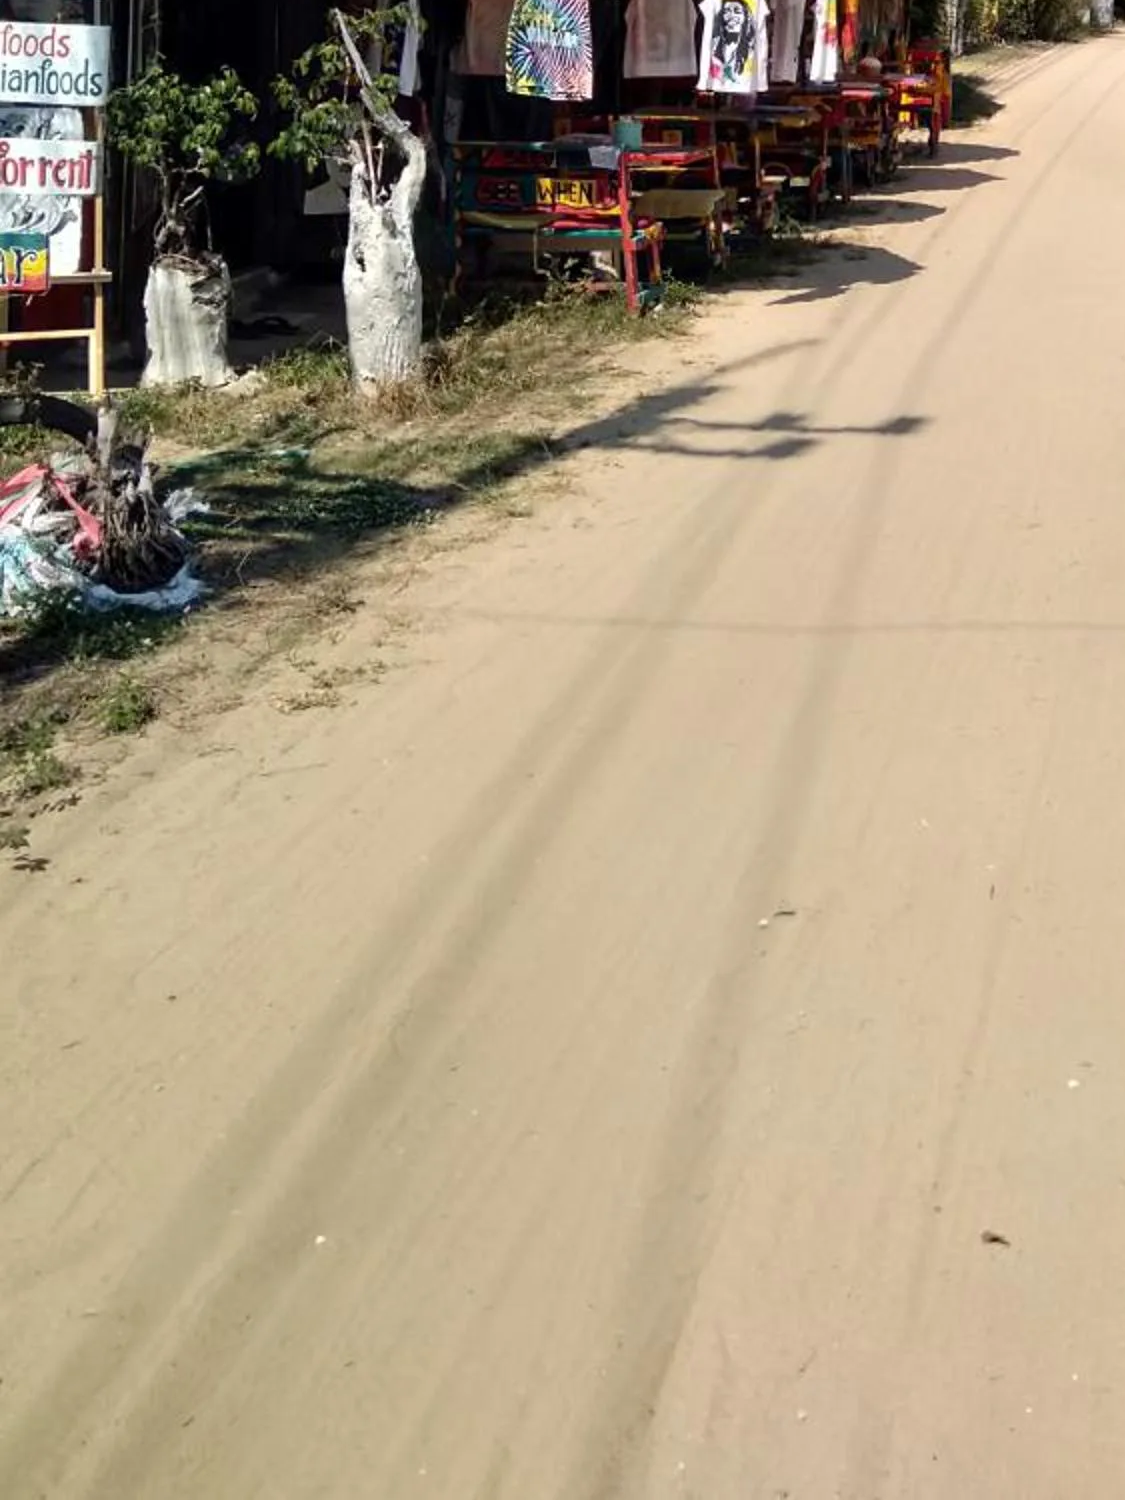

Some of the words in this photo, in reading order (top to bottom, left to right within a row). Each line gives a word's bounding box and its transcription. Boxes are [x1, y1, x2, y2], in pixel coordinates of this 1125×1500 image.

[0, 23, 71, 58] foods
[37, 149, 94, 190] rent
[536, 179, 594, 206] WHEN
